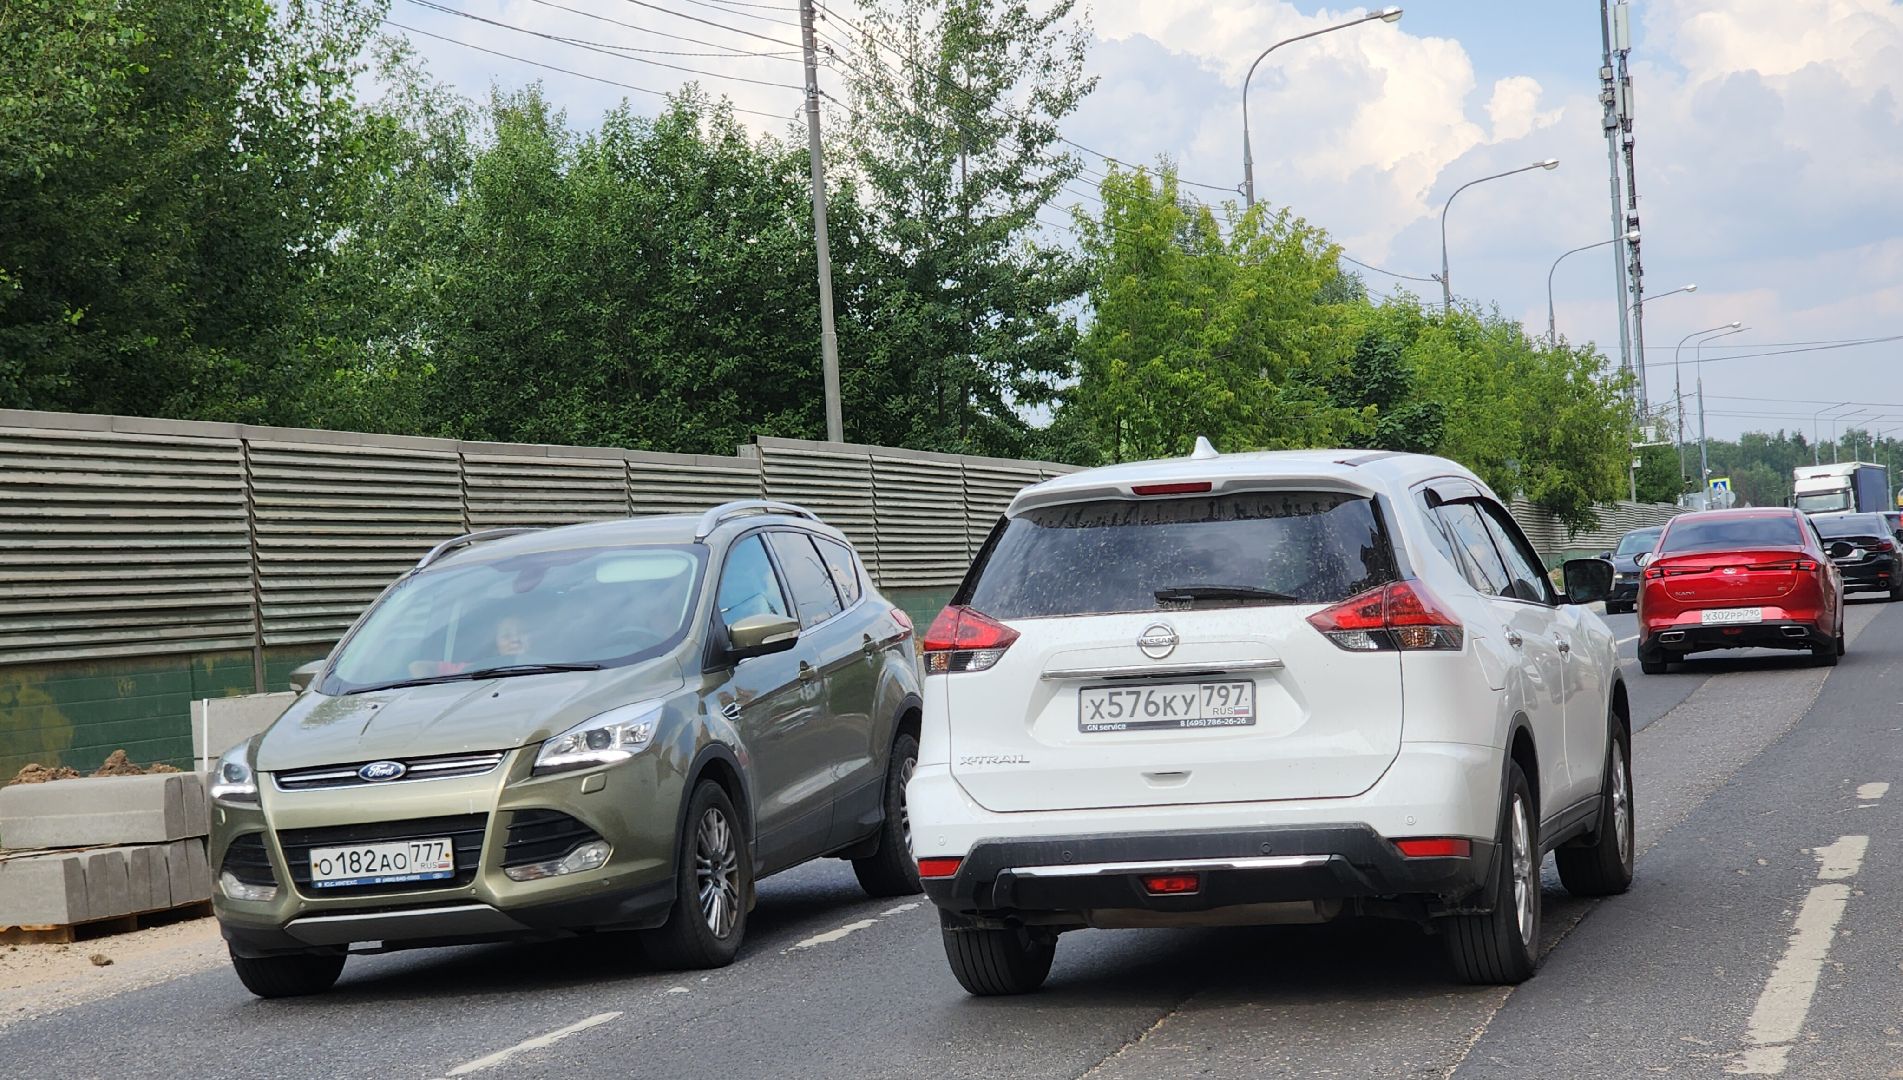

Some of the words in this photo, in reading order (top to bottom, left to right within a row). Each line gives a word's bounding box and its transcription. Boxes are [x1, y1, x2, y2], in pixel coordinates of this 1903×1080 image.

[1140, 637, 1174, 645] NISSAN
[1202, 685, 1245, 707] 797
[1213, 706, 1233, 716] RUS
[1099, 723, 1126, 731] service
[367, 764, 395, 778] Ford
[411, 842, 444, 862] 777
